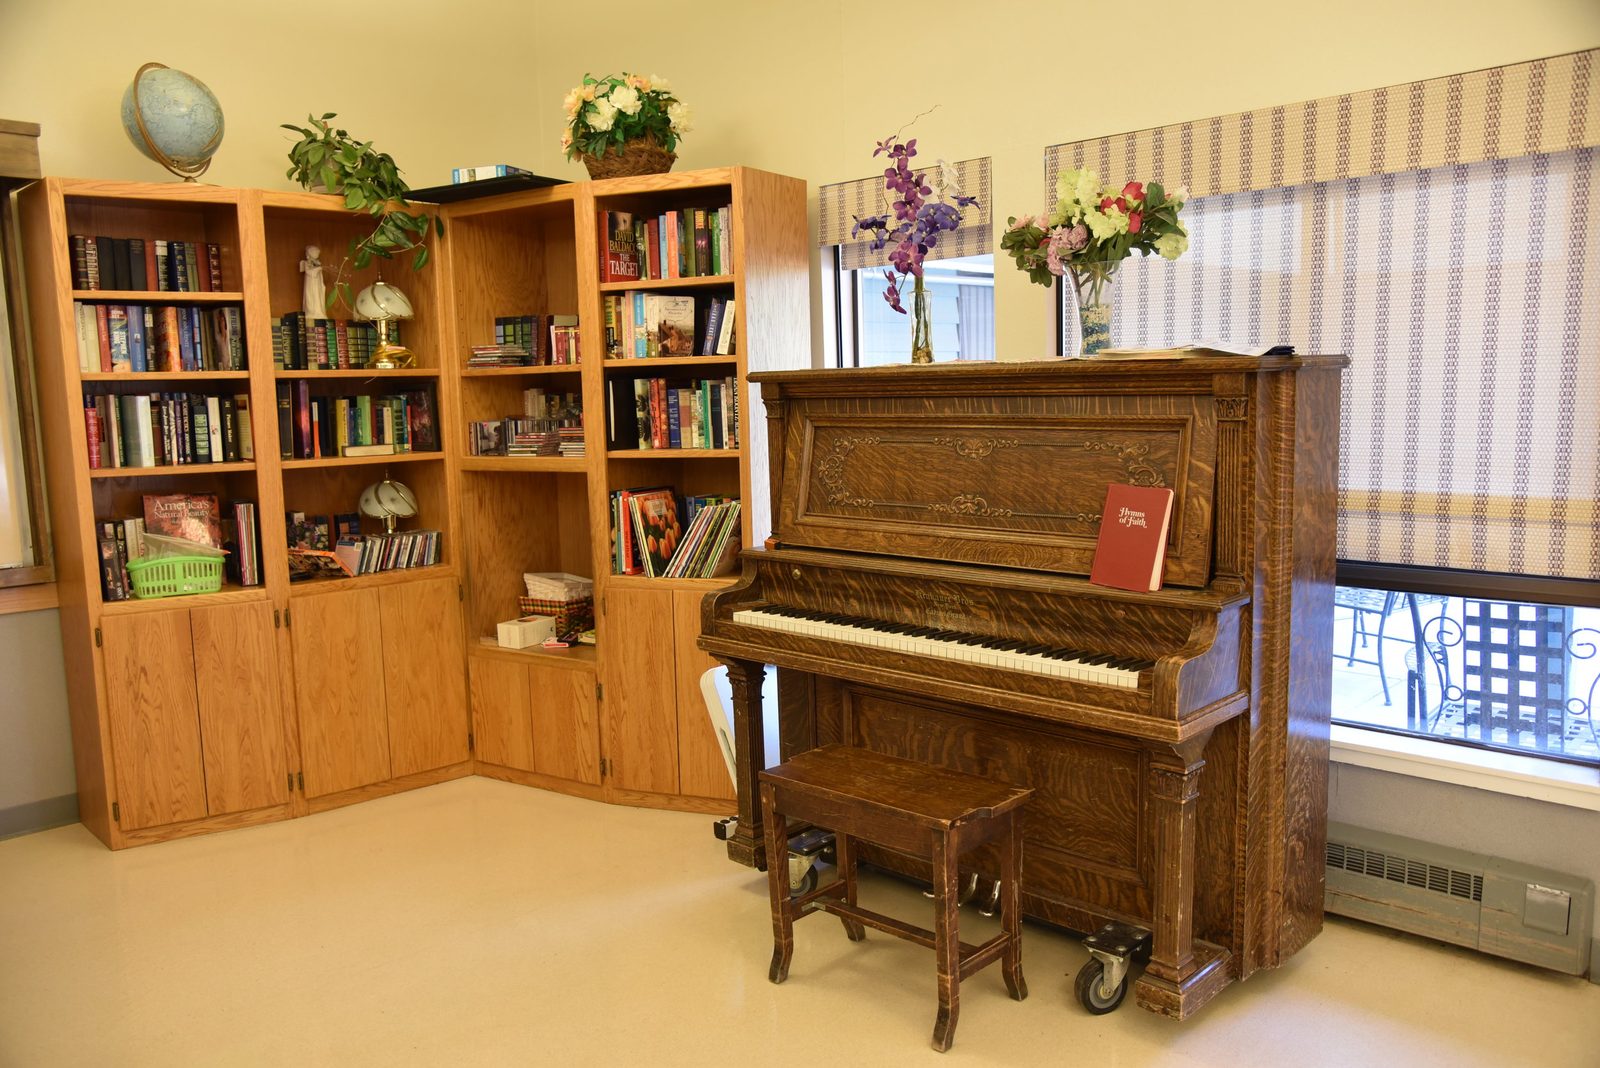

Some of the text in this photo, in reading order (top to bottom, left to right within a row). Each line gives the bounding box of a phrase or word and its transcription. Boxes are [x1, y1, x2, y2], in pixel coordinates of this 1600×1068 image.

[615, 230, 634, 241] DAVID
[609, 240, 637, 252] BALDACC
[619, 253, 630, 261] THE
[609, 260, 639, 276] TARGET
[154, 499, 209, 510] America's
[154, 510, 183, 519] Natural
[1118, 507, 1145, 517] Hymns
[1119, 515, 1147, 528] of Faith
